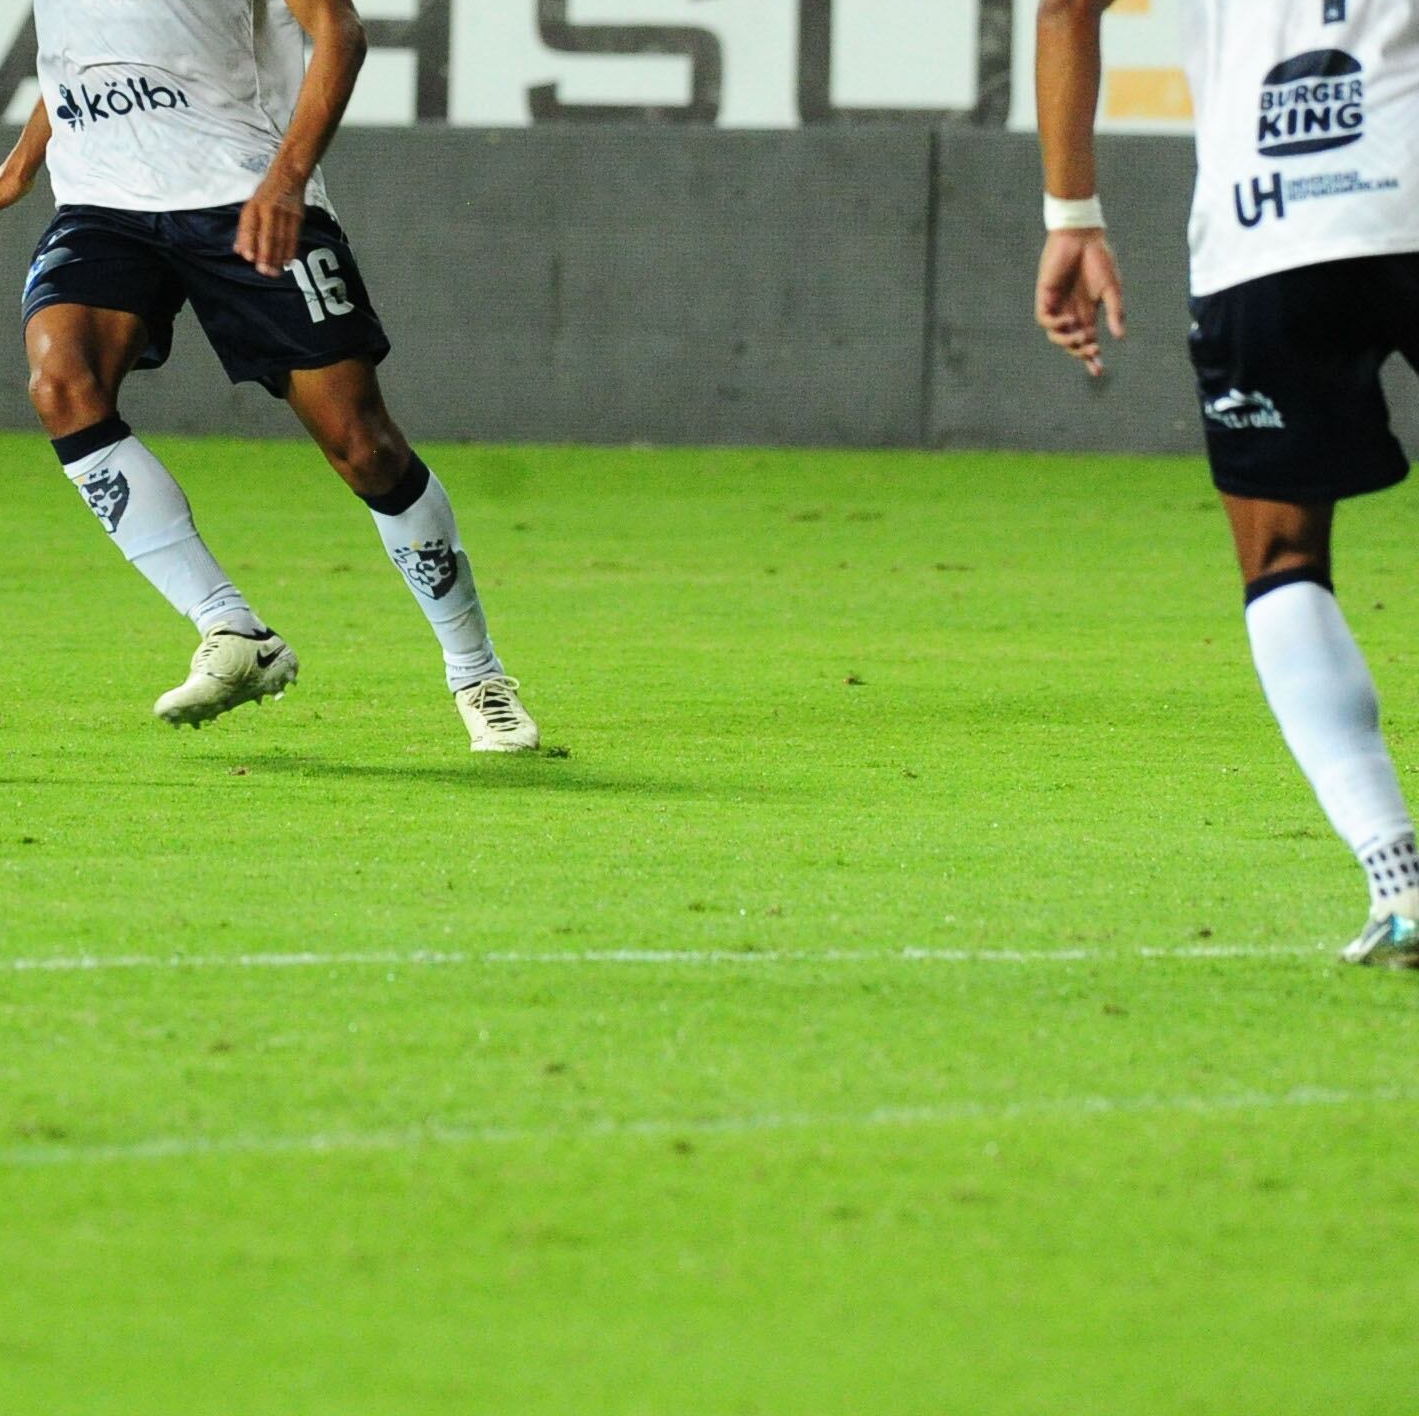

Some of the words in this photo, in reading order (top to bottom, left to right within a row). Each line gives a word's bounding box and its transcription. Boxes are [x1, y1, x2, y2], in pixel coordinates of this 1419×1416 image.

[82, 77, 191, 123] kölbi
[1259, 79, 1364, 111] BURGER
[1258, 102, 1364, 142] KING
[1233, 172, 1285, 228] UH
[283, 247, 355, 325] 16
